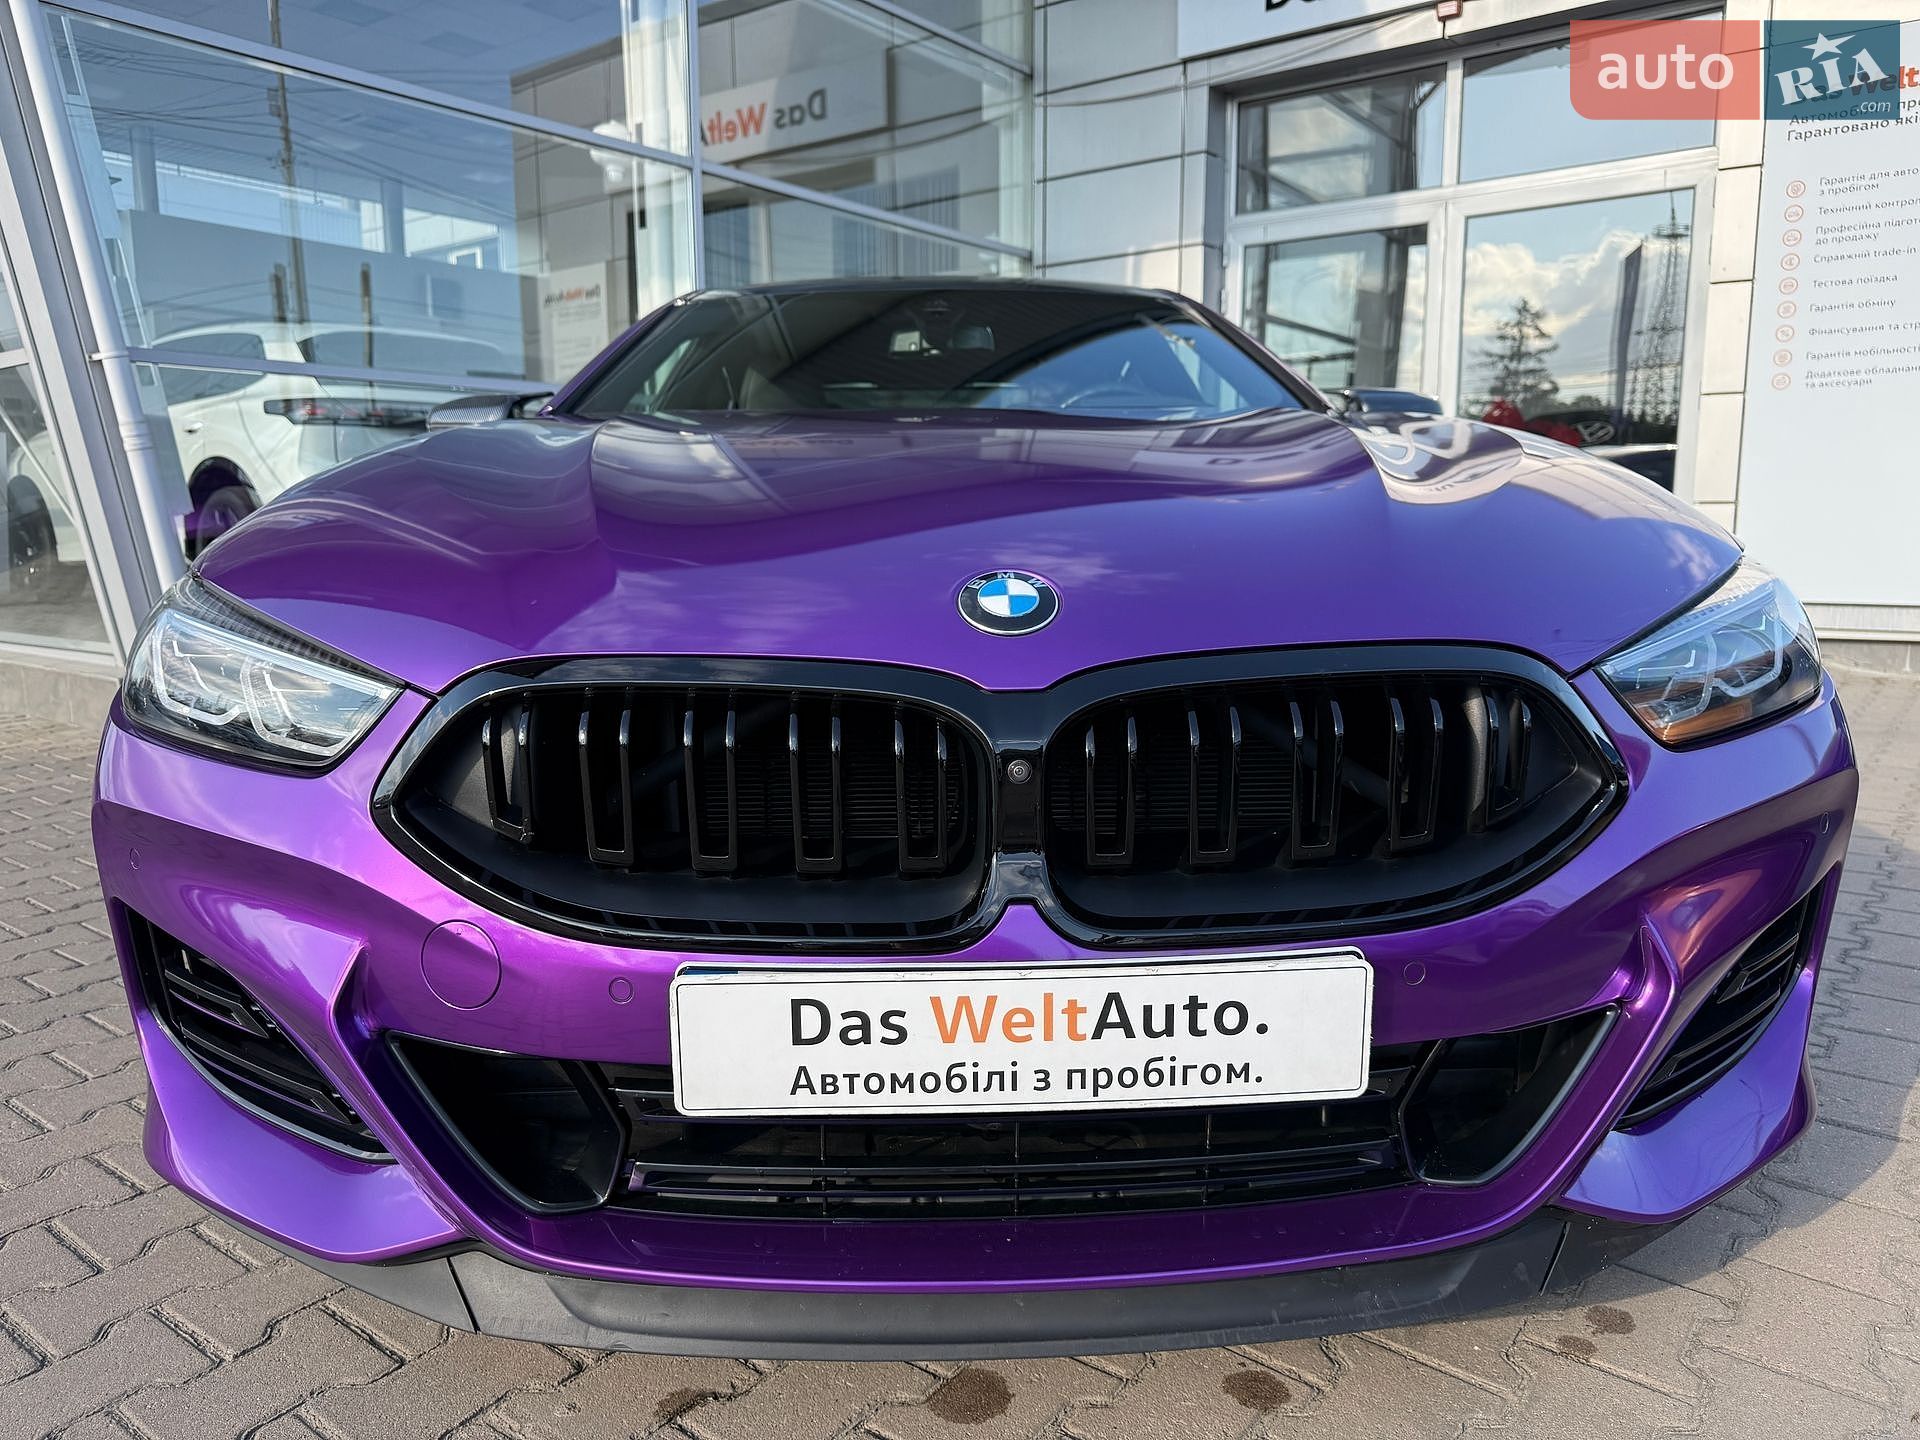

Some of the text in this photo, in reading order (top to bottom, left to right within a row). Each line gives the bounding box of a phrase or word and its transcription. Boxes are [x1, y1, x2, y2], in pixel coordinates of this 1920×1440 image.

[1787, 120, 1890, 141] Гарантовано
[1820, 173, 1865, 186] Гарантія
[1869, 171, 1890, 181] для
[1828, 183, 1880, 196] пробігом
[1818, 201, 1872, 215] Технічний
[1815, 232, 1879, 246] до продажу
[1874, 246, 1917, 257] trade-in
[1813, 278, 1853, 289] Тестова
[1809, 297, 1896, 313] Гарантія обміну
[1888, 323, 1899, 331] та
[1806, 349, 1851, 361] Гарантія
[1805, 367, 1861, 379] Додаткове
[1805, 378, 1872, 390] та аксесуари
[790, 991, 1270, 1047] Das WeltAuto.
[789, 1056, 1264, 1096] Автомобілі з пробігом.
